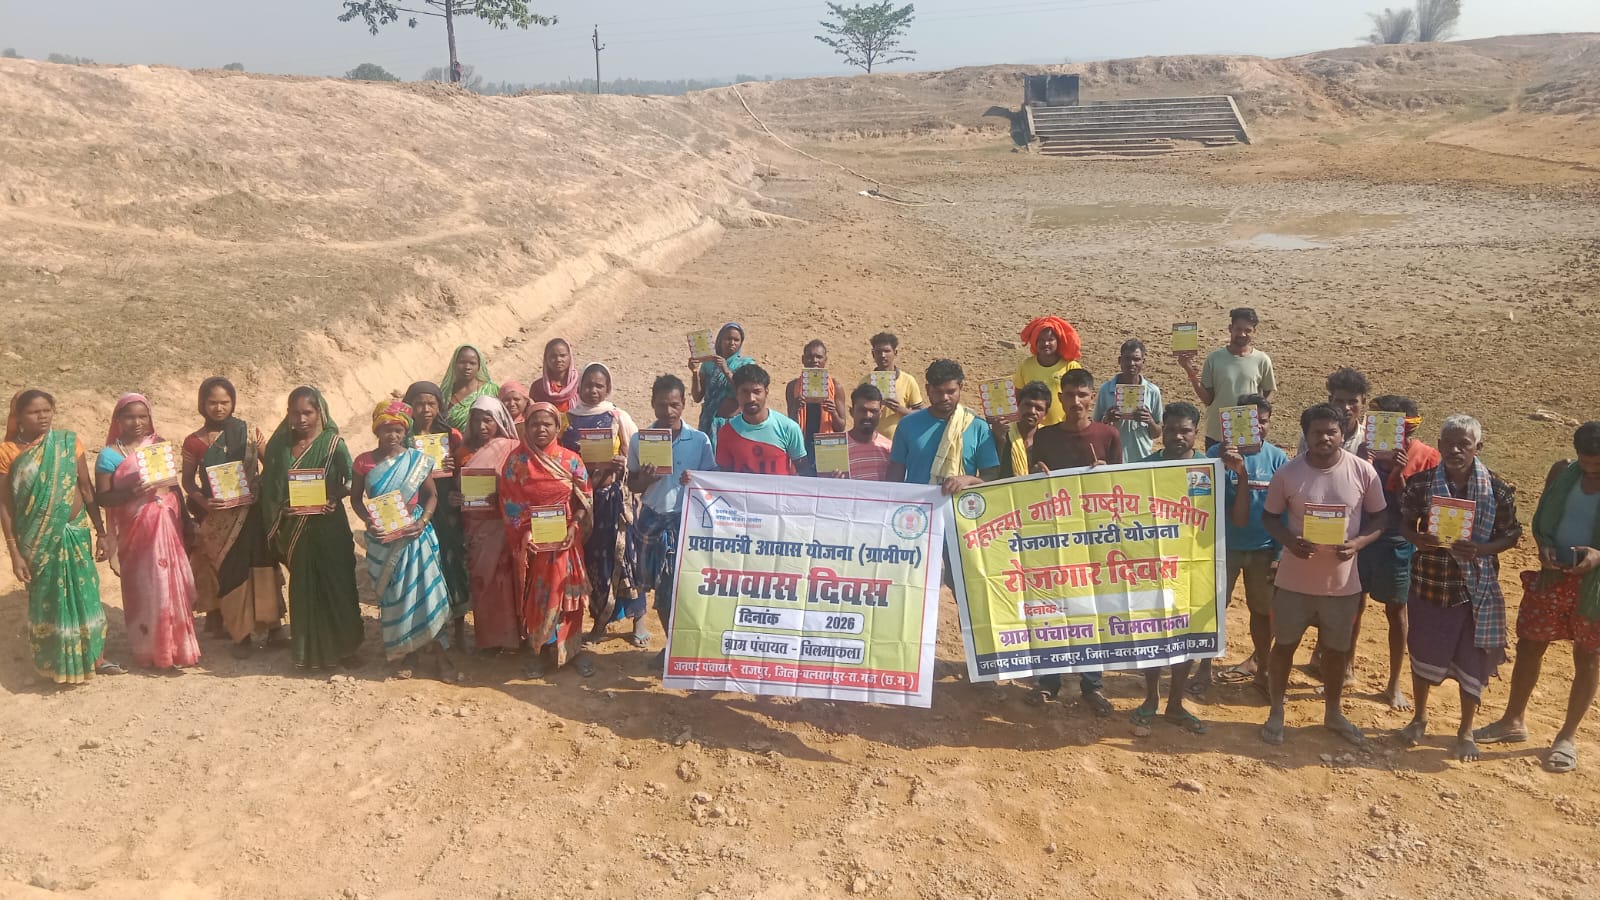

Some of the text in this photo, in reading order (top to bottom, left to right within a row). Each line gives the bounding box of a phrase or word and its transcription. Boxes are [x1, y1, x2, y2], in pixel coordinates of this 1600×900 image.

[963, 484, 1210, 550] महात्मा गांधी राष्ट्रीय ग्रामीण
[688, 534, 922, 568] प्रधानमंत्री आवास योजना (ग्रामीण)
[1008, 520, 1179, 553] रोजगार गारंटी योजना
[698, 566, 892, 607] आवास दिवस
[1002, 549, 1180, 594] रोजगार दिवस
[738, 608, 855, 630] दिनांक 2026
[1023, 601, 1058, 616] दिनांक
[724, 638, 746, 653] ग्राम
[750, 636, 789, 654] पंचायत
[1000, 627, 1030, 647] ग्राम
[1036, 622, 1094, 642] पंचायत
[1109, 614, 1190, 636] चिमलाकला
